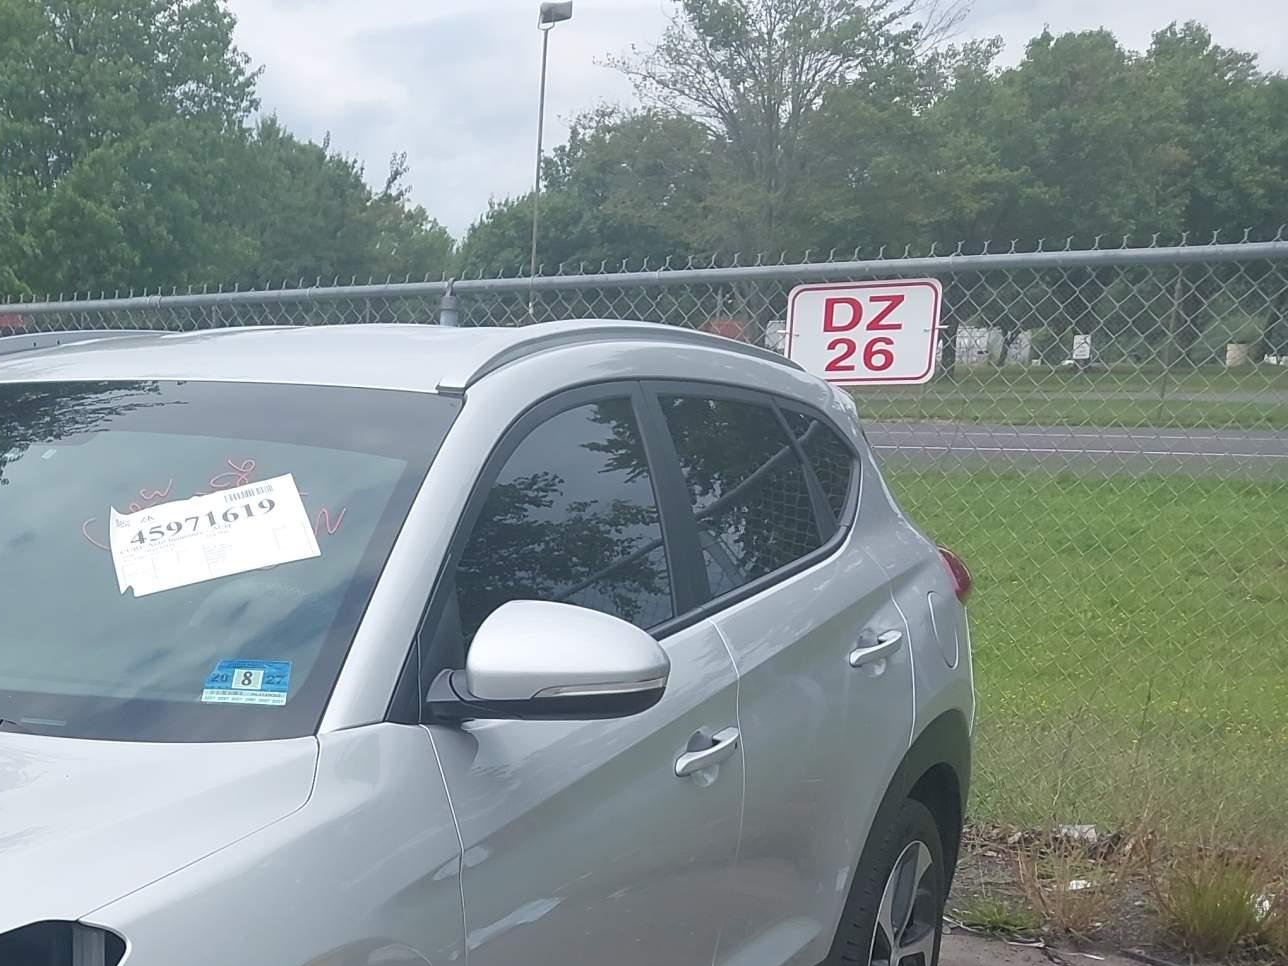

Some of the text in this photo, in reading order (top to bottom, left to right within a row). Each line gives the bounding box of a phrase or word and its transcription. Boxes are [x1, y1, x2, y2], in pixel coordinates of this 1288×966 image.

[823, 294, 905, 333] DZ
[824, 336, 895, 372] 26
[129, 498, 276, 545] 45971619
[241, 671, 253, 686] 8
[265, 675, 285, 685] 27
